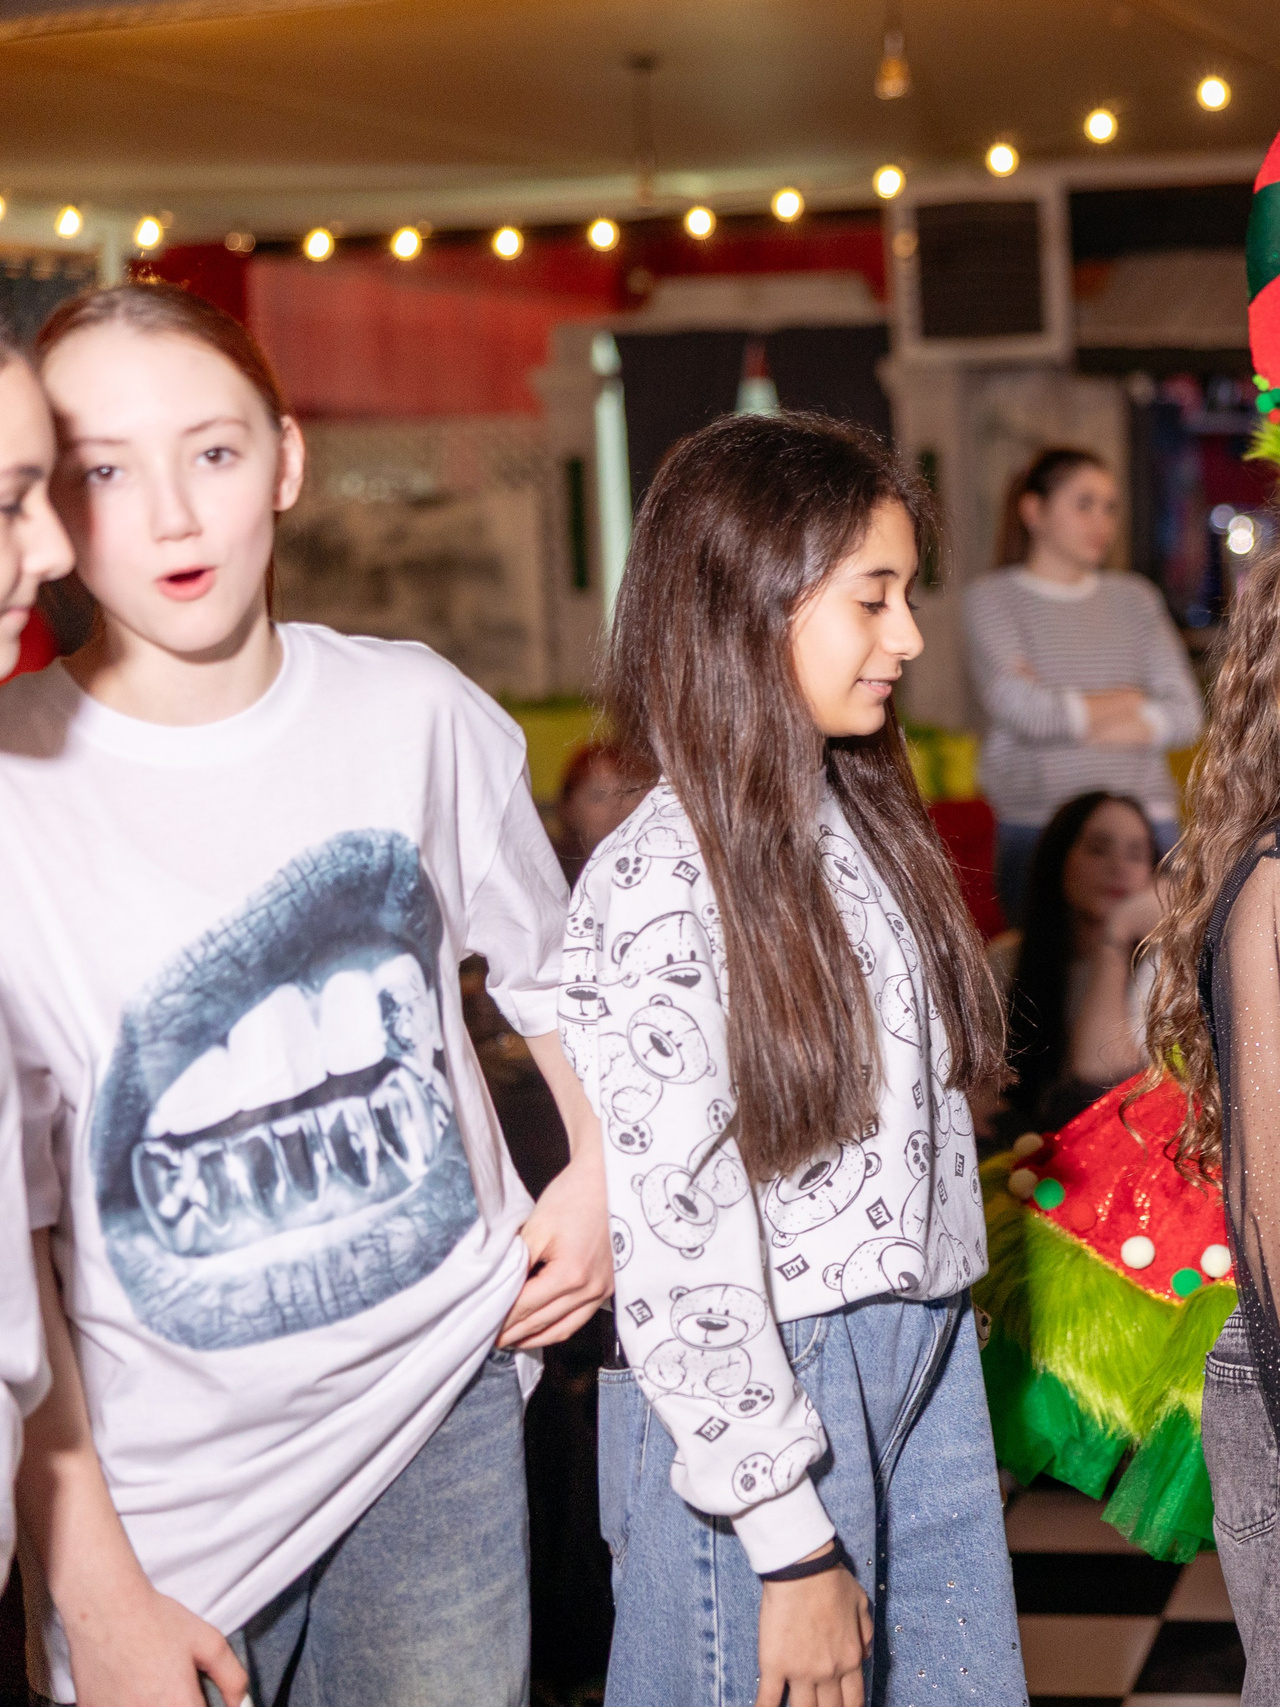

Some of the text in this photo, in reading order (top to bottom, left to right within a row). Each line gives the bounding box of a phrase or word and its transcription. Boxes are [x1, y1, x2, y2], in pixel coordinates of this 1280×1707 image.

[867, 1201, 892, 1227] HT
[779, 1255, 807, 1279] HT
[627, 1300, 652, 1324] HT
[697, 1418, 727, 1440] HT
